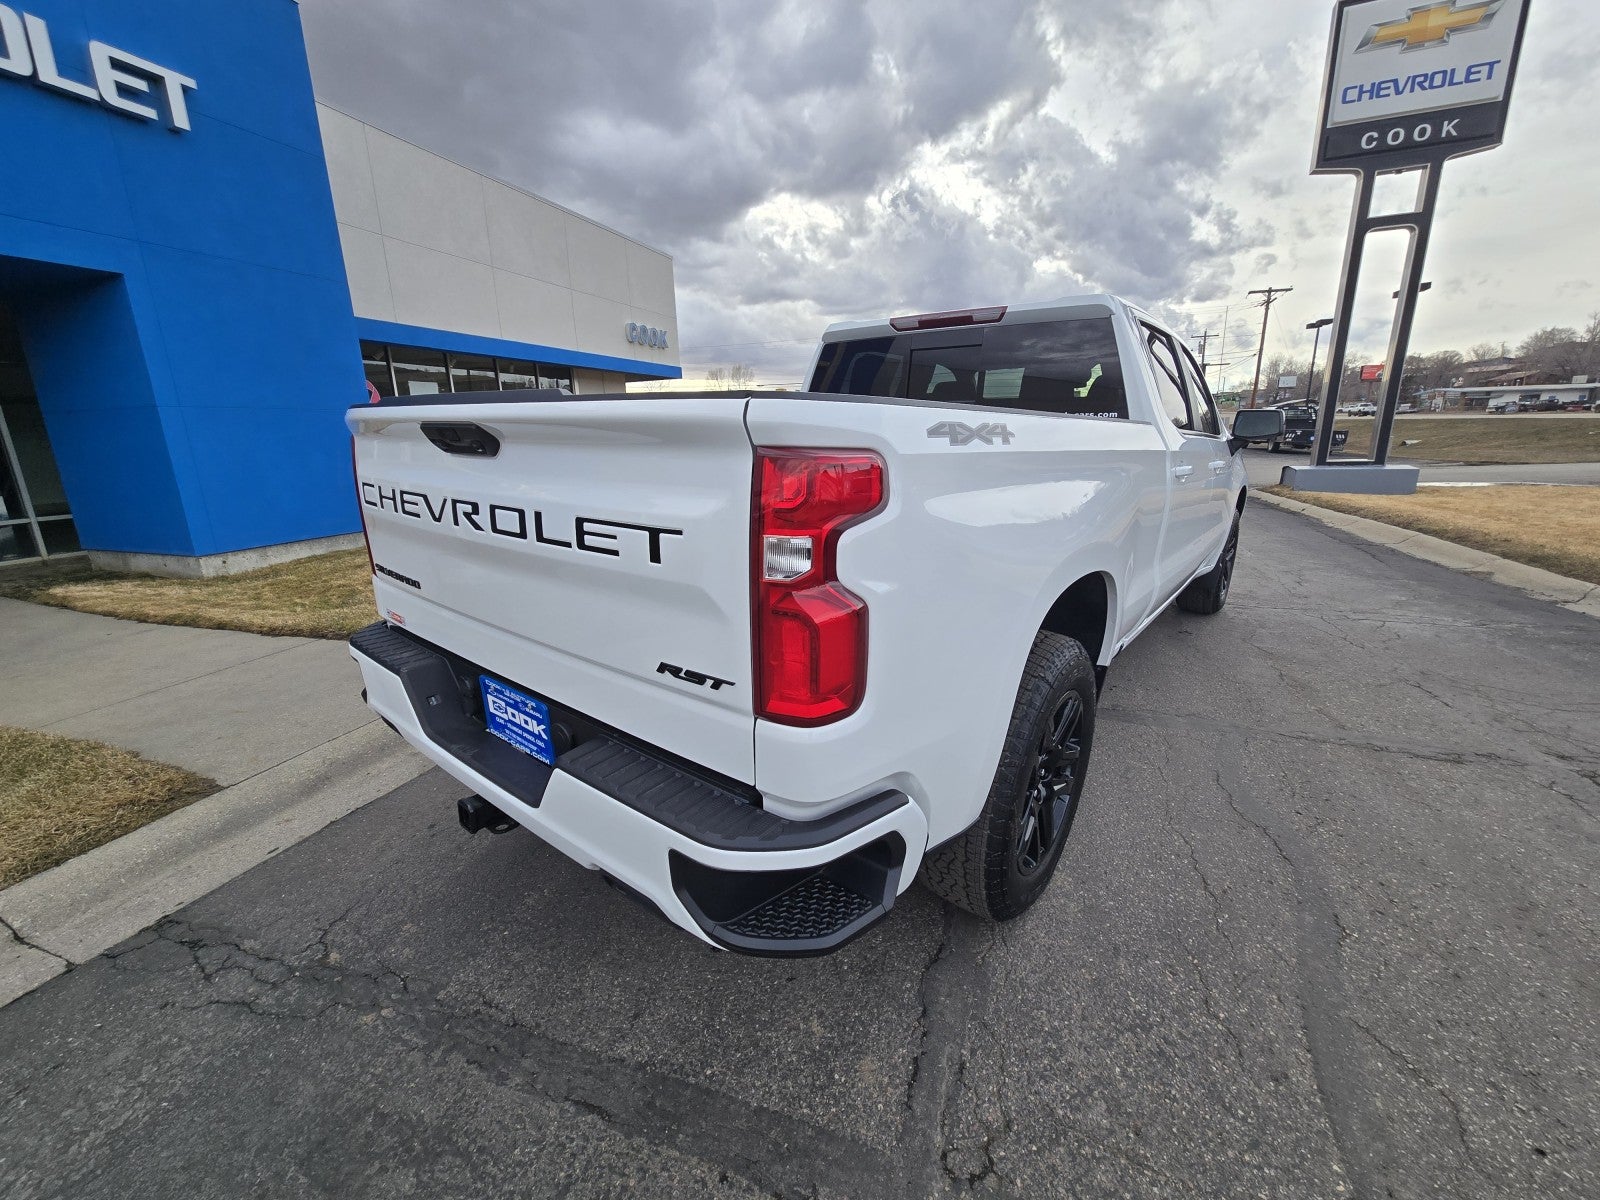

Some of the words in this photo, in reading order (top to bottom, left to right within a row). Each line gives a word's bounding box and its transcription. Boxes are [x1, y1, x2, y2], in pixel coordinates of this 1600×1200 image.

[1341, 60, 1501, 104] CHEVROLET
[1361, 119, 1461, 149] COOK
[625, 322, 669, 349] COOK
[361, 481, 684, 565] CHEVROLET
[656, 661, 736, 690] RST
[487, 694, 548, 740] COOK
